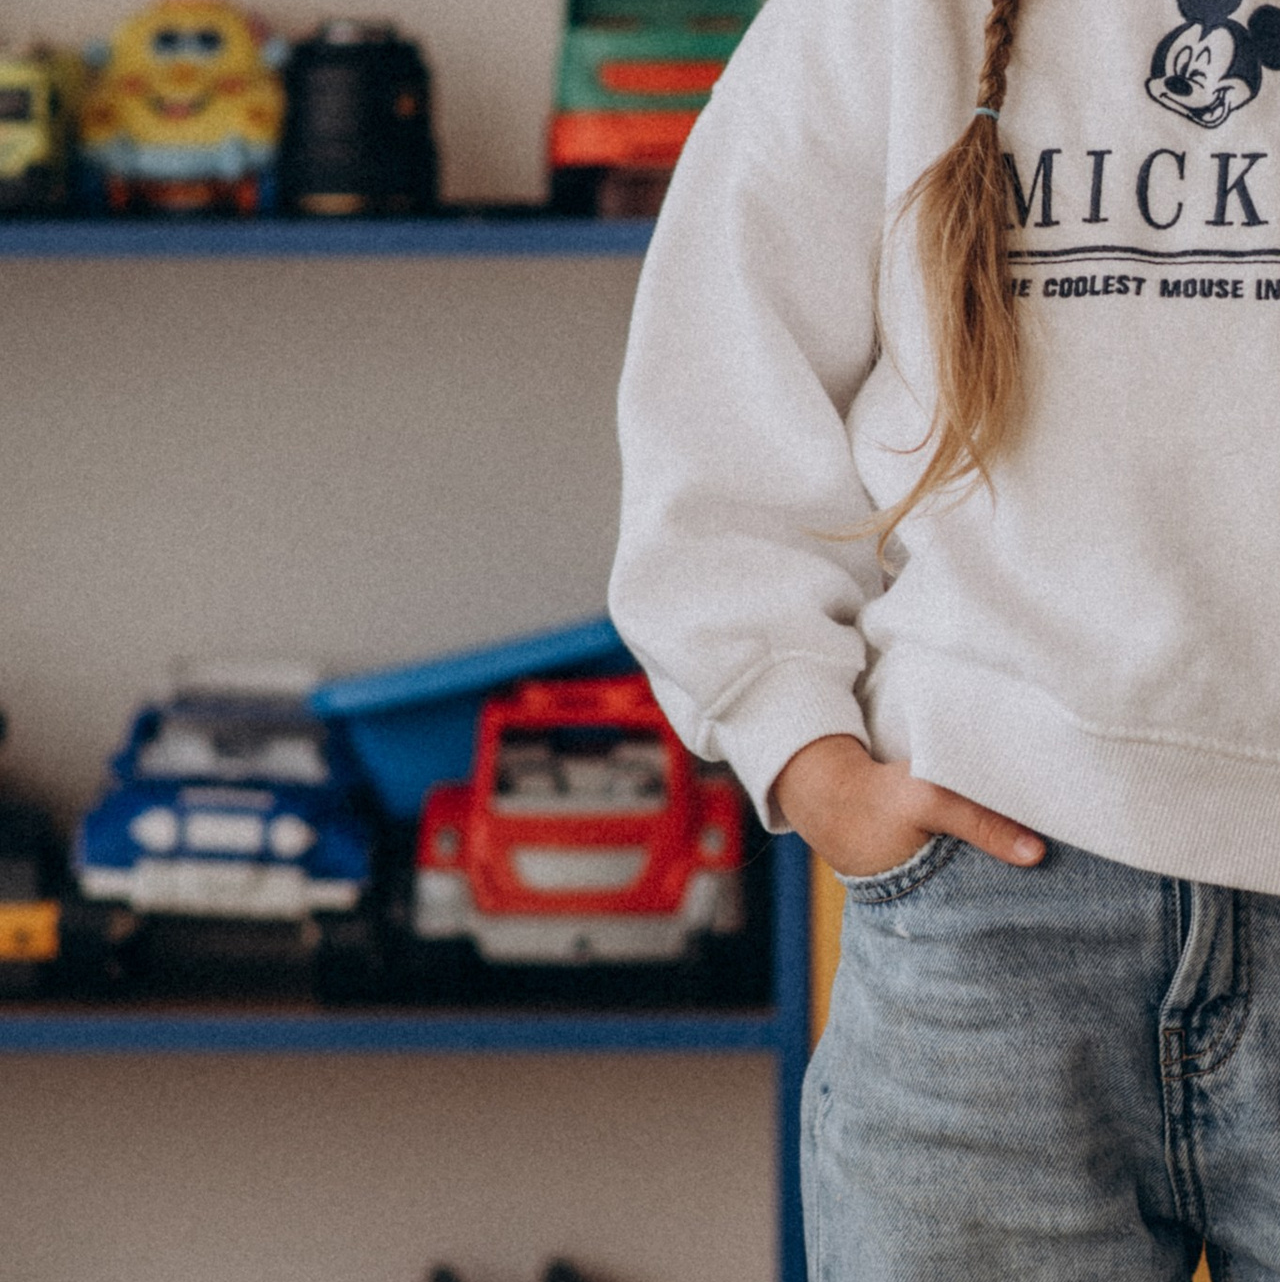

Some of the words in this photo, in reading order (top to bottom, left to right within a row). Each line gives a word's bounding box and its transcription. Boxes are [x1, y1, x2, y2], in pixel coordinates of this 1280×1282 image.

[1042, 274, 1147, 298] COOLEST
[1159, 277, 1244, 299] MOUSE
[1255, 278, 1280, 300] IN
